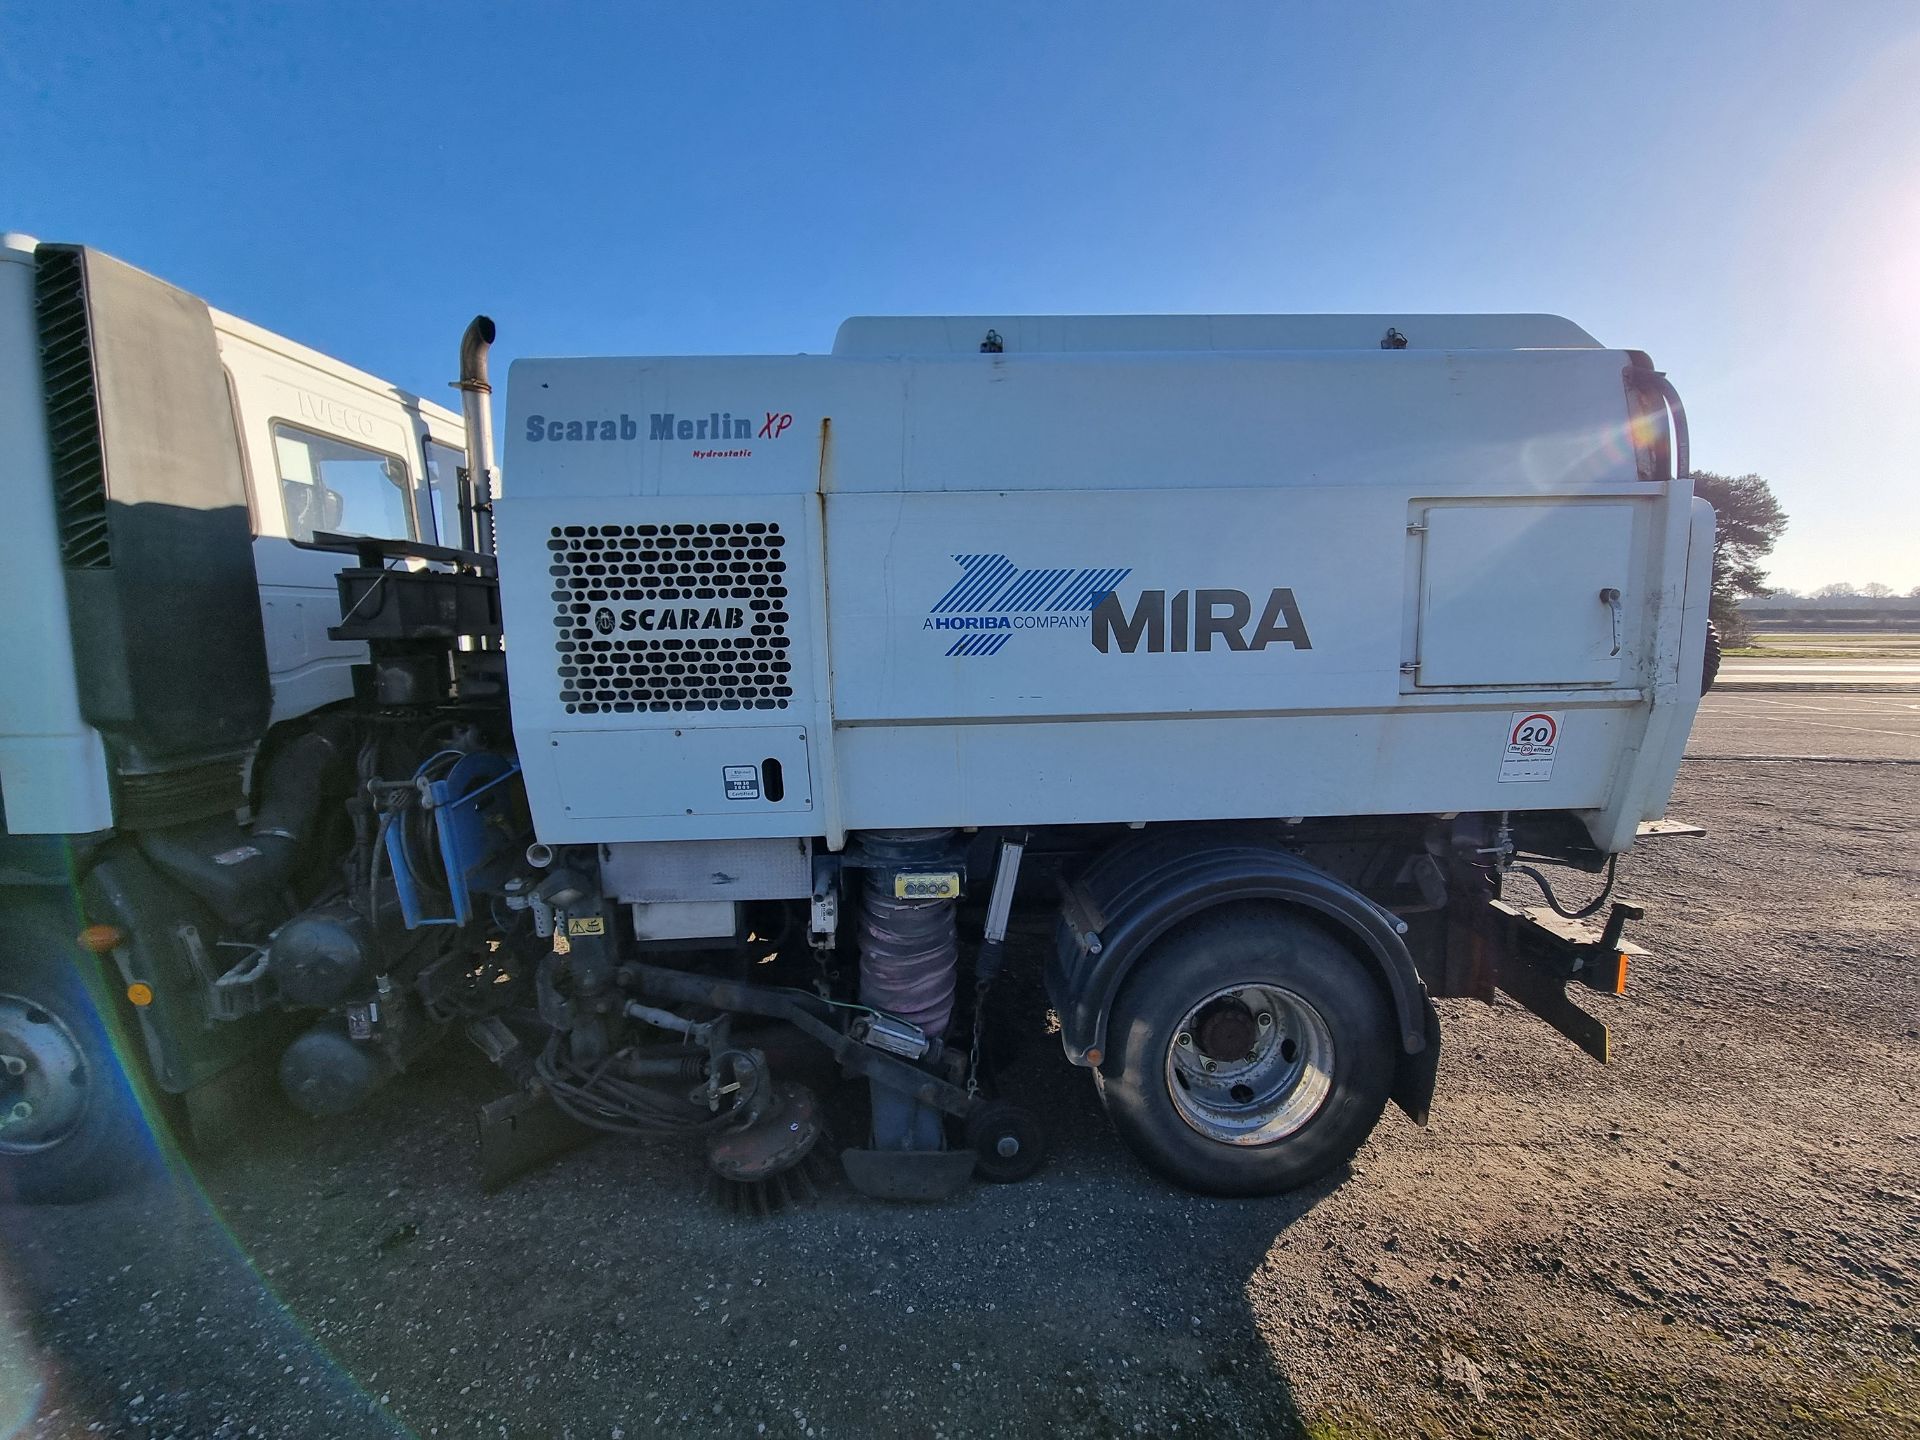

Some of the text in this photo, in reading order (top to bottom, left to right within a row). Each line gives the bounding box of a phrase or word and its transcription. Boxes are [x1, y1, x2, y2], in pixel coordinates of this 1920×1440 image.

[298, 391, 375, 440] IVECO
[526, 412, 792, 442] Scarab Merlin XP
[692, 449, 752, 459] Hydrostatic
[619, 608, 744, 631] SCARAB
[923, 615, 1090, 630] A HORIBA COMPANY
[1091, 588, 1312, 654] MIRA
[1521, 727, 1548, 742] 20
